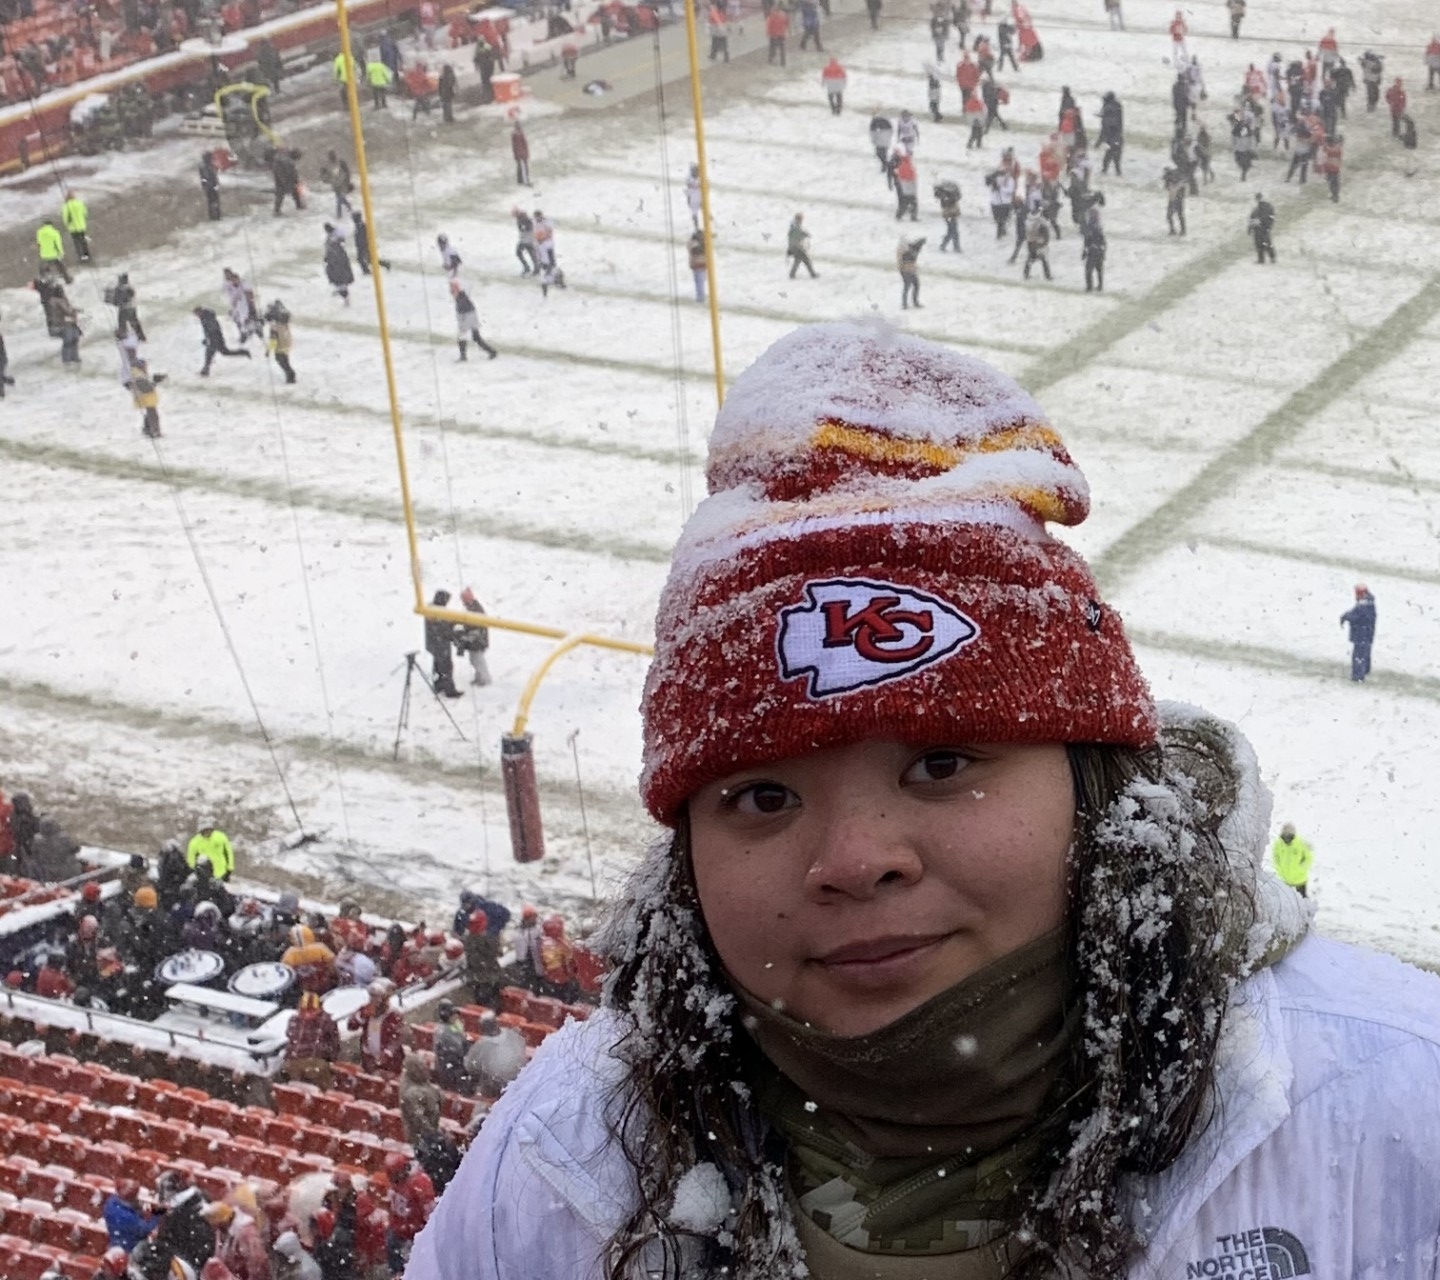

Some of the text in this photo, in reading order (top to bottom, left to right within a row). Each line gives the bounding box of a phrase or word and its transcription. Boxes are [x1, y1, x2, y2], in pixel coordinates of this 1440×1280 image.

[820, 596, 935, 664] KC
[1216, 1227, 1264, 1253] THE
[1186, 1247, 1268, 1280] NORTH
